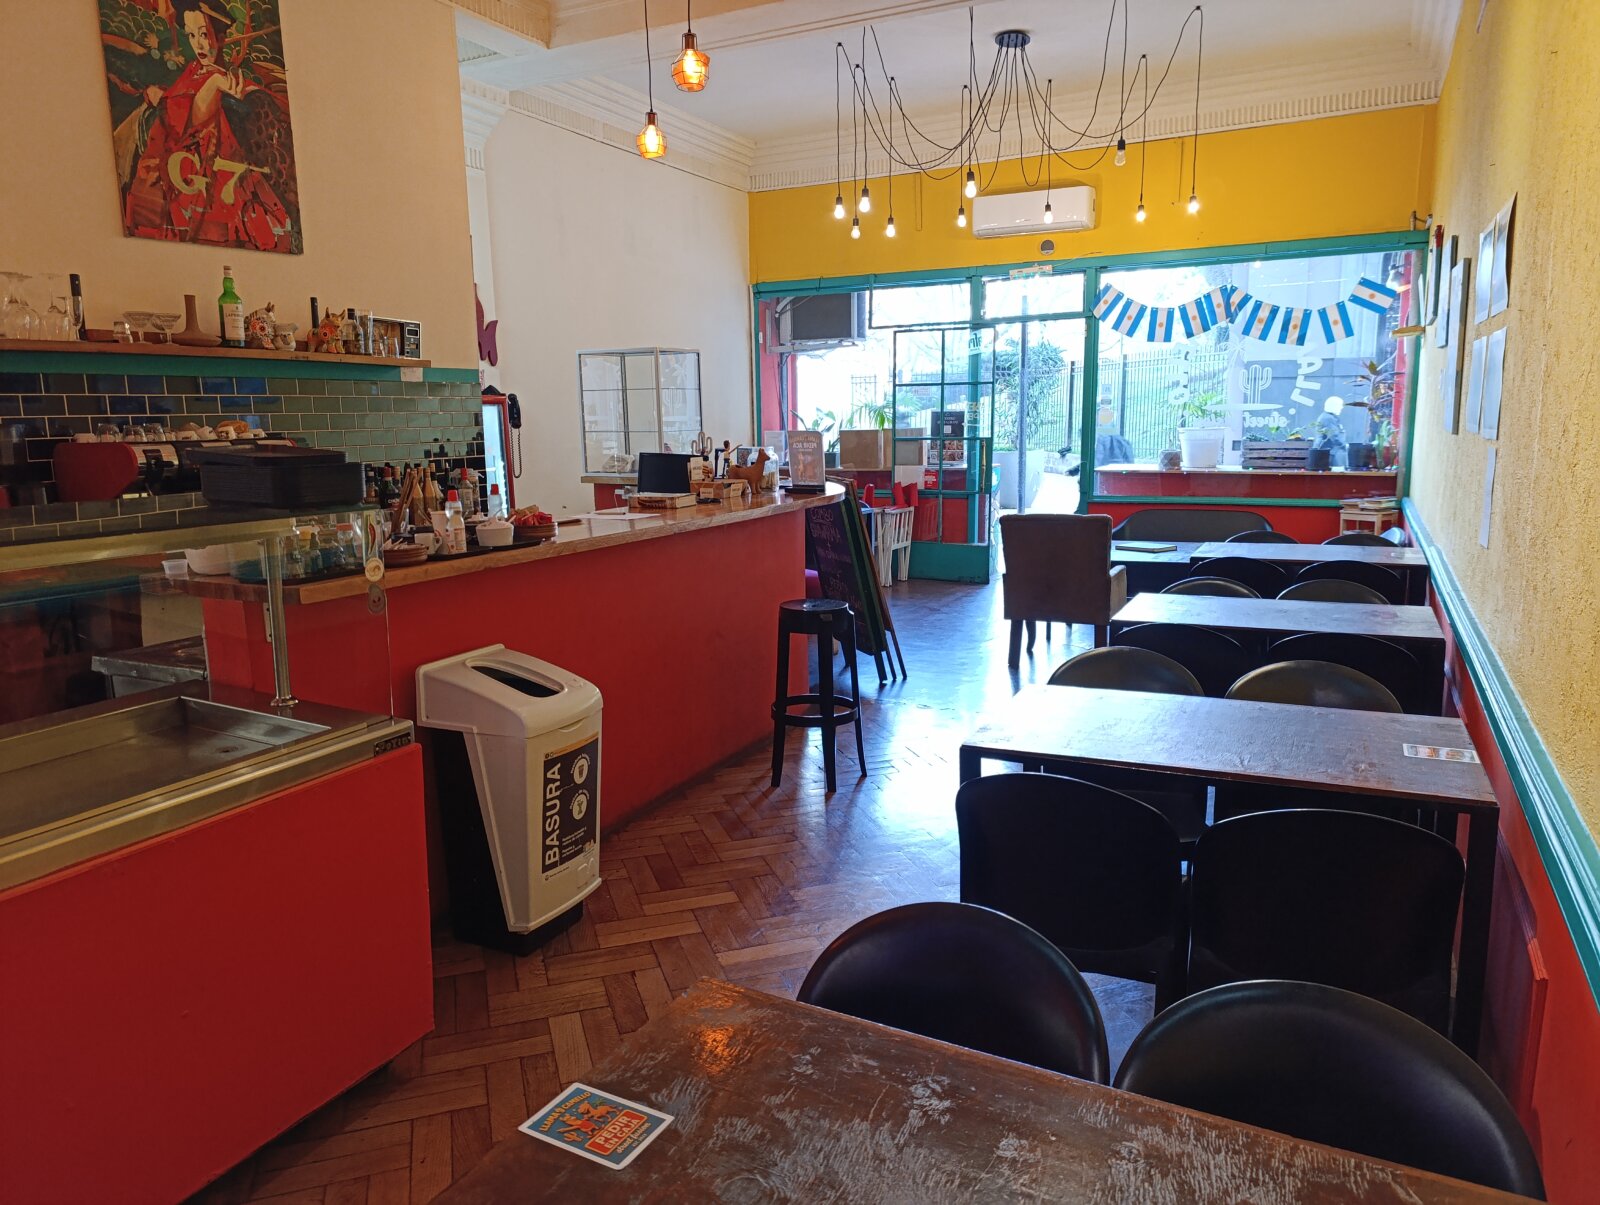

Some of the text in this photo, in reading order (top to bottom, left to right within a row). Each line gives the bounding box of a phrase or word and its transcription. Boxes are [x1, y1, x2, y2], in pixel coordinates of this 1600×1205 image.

[545, 764, 560, 866] BASURA
[539, 1108, 561, 1131] LLAMA
[562, 1092, 591, 1109] CAMELLO
[595, 1116, 631, 1145] PEDIR
[605, 1137, 618, 1149] EN
[618, 1119, 641, 1140] CAJA
